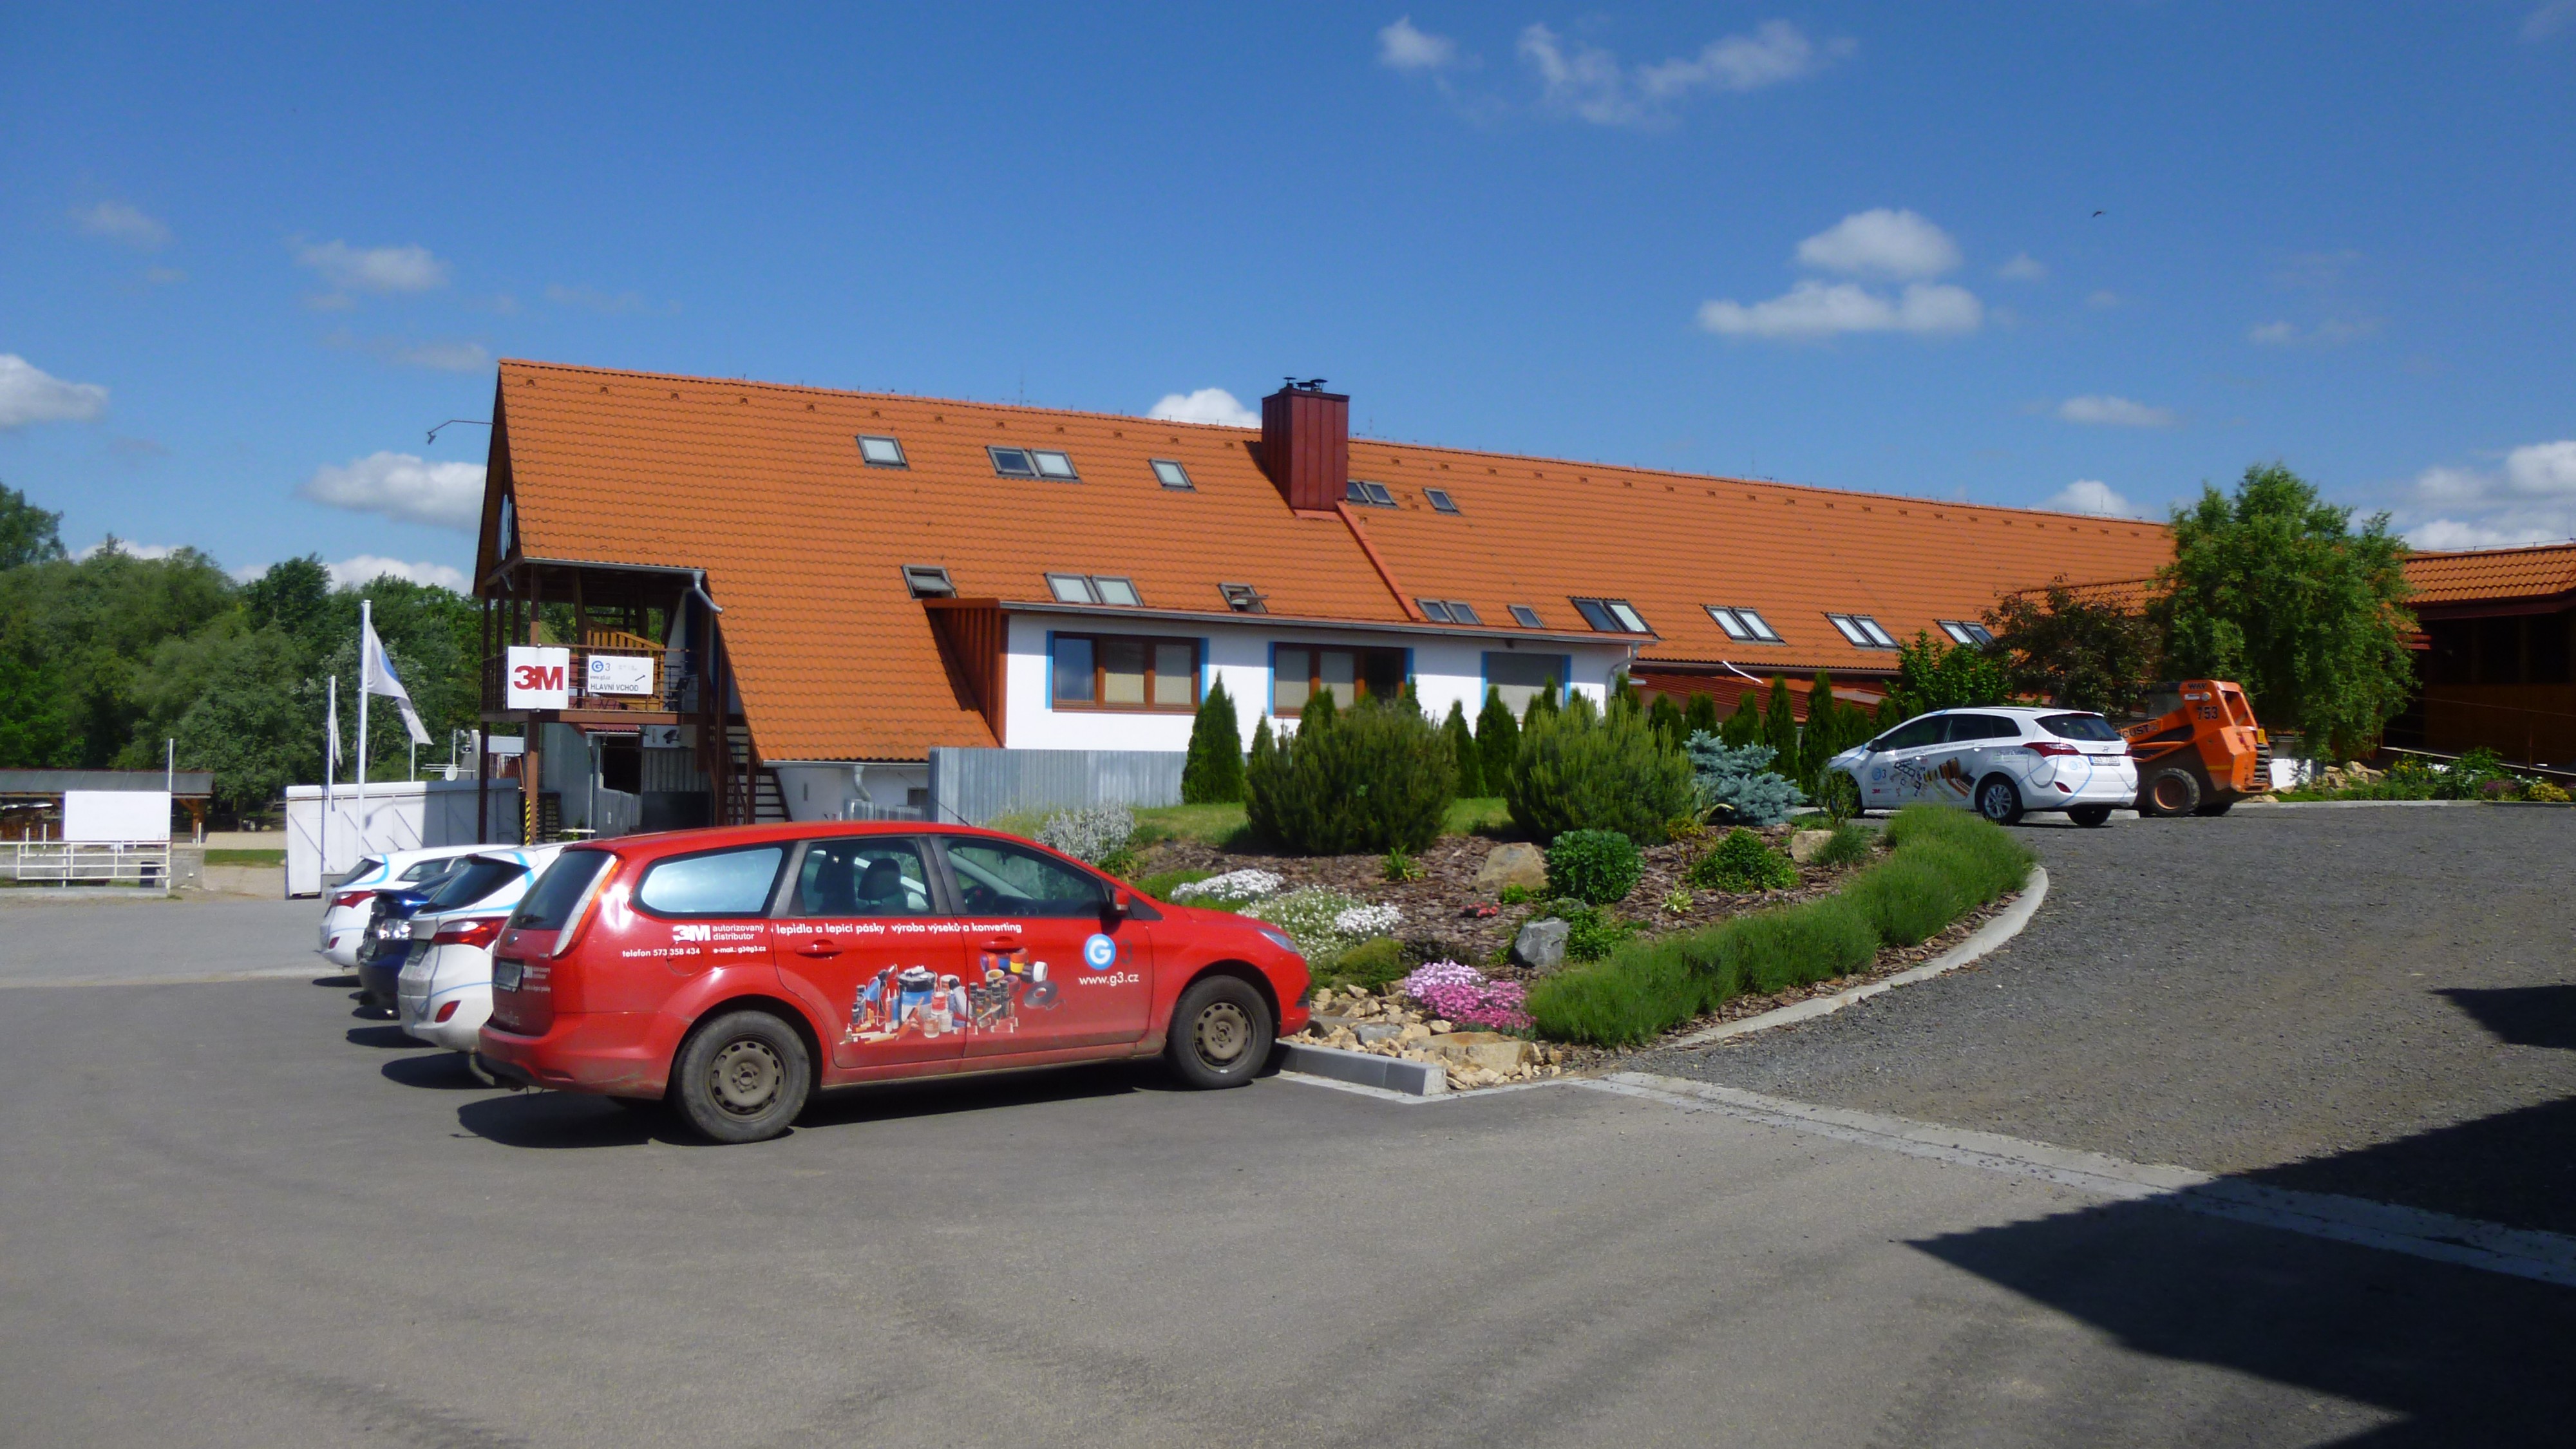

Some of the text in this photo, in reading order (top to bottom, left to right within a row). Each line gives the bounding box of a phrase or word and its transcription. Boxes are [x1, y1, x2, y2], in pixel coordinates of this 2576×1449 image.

[514, 665, 564, 690] 3M
[2197, 706, 2218, 720] 753
[672, 925, 712, 942] 3M
[712, 923, 764, 933] autorizovaný
[776, 923, 813, 936] lepidla
[856, 923, 885, 934] pásky
[891, 923, 925, 934] výroba
[928, 922, 960, 934] výseků
[972, 922, 1022, 933] konverting
[622, 949, 650, 957] telefon
[1079, 971, 1139, 987] www.g3.cz
